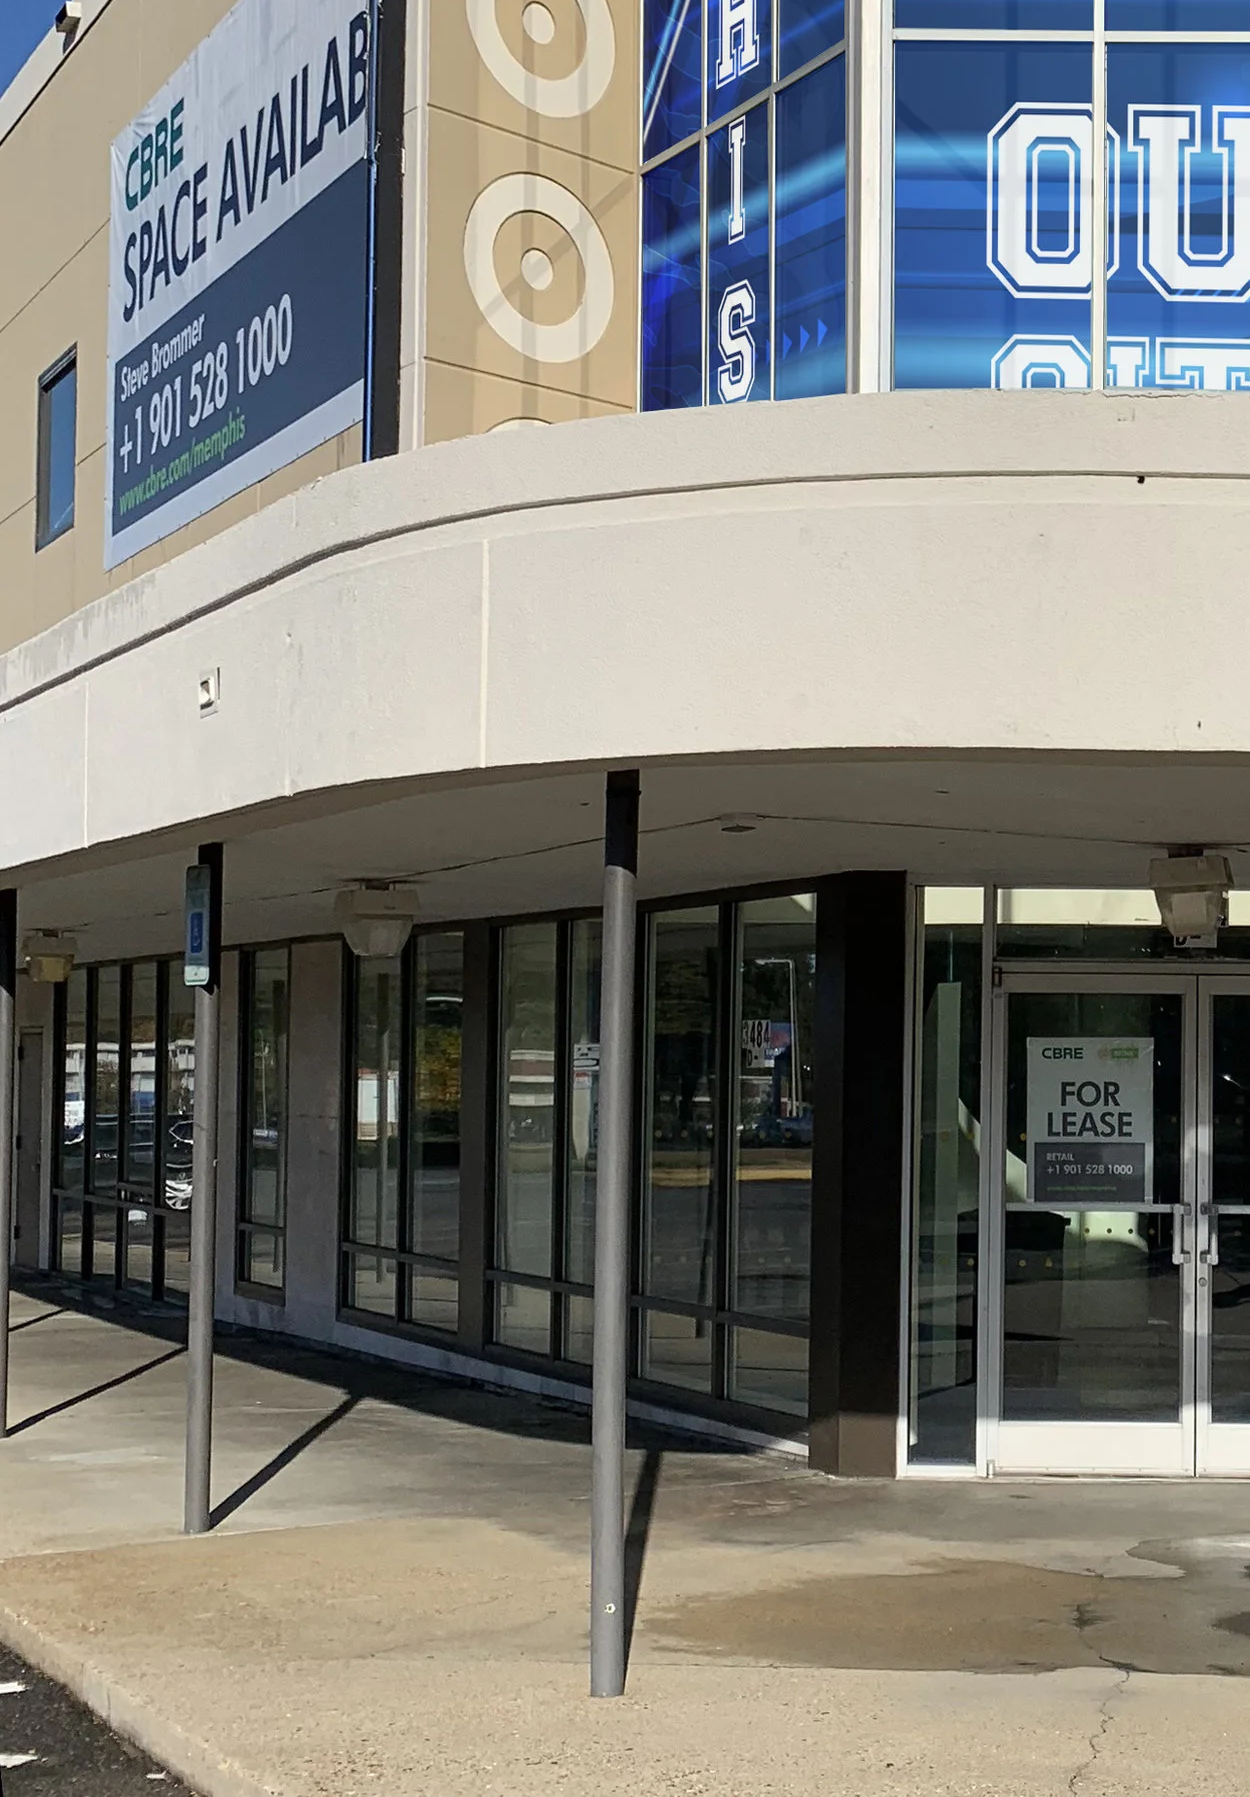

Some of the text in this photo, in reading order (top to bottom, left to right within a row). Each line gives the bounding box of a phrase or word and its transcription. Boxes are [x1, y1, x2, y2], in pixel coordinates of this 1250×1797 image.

[122, 9, 367, 323] SPACE AVAILAB
[125, 97, 184, 212] CBRE
[120, 313, 206, 403] Steve Brommer
[119, 293, 293, 474] +1 901 528 1000
[1042, 1047, 1084, 1060] CBRE
[1060, 1080, 1121, 1107] FOR
[1047, 1111, 1133, 1138] LEASE
[1046, 1152, 1075, 1162] RETAIL
[1047, 1164, 1134, 1175] +1 901 528 1000
